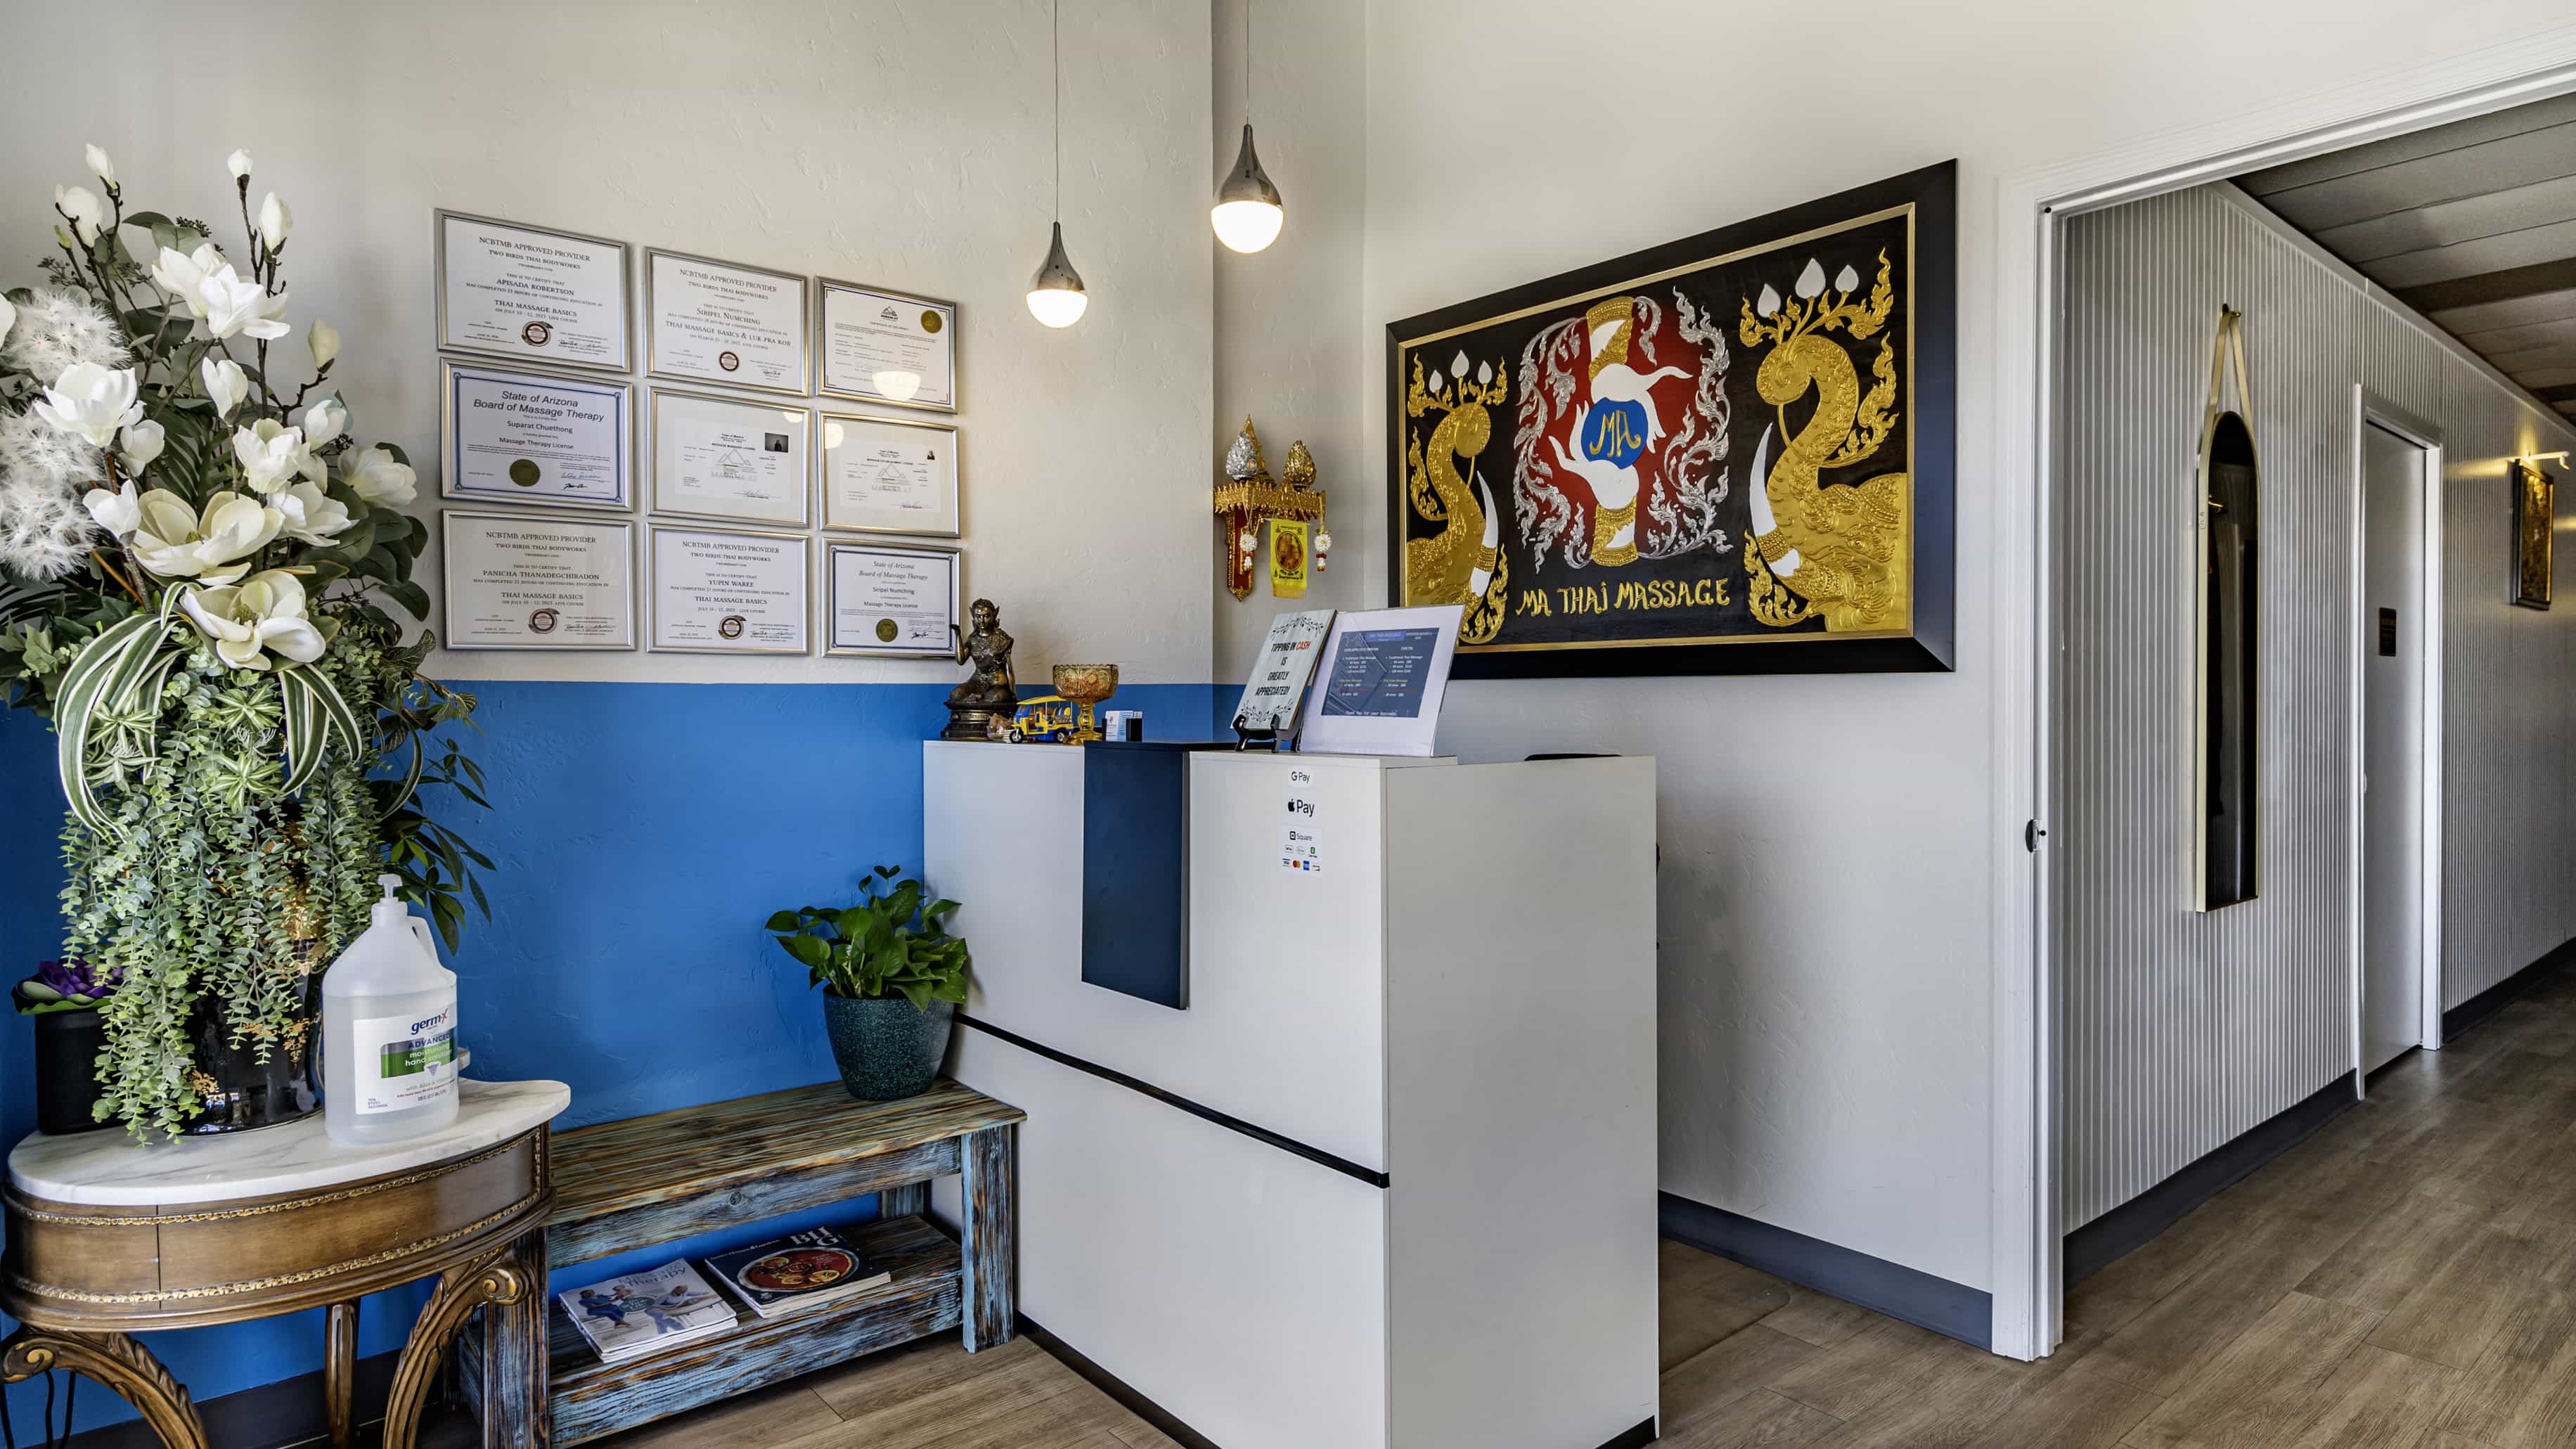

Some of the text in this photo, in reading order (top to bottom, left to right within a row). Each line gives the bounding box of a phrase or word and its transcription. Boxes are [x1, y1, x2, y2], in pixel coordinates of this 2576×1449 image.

[479, 237, 591, 262] NCBTMB APPROVED PROVIDER
[543, 259, 581, 269] BODYWORKS
[496, 279, 574, 295] APISADA ROBERTSON
[680, 269, 777, 292] NCBTMB APPROVED PROVIDER
[495, 300, 513, 308] THAI
[516, 303, 550, 313] MASSAGE
[685, 324, 715, 334] MASSAGE
[718, 330, 739, 338] BASICS
[501, 391, 527, 401] State
[542, 396, 578, 407] Arizona
[473, 399, 604, 422] Board of Massage Therapy
[507, 421, 573, 434] Suparat Chuethong
[1589, 409, 1642, 458] MA
[499, 437, 526, 446] Massage
[527, 439, 552, 449] Therapy
[520, 534, 559, 542] APPROVED
[682, 541, 711, 549] NCBTMB
[1515, 588, 1552, 617] MA
[1614, 577, 1731, 612] MASSAGE
[1271, 641, 1311, 652] TIPPING IN CASH
[1280, 657, 1287, 666] IS
[1268, 671, 1290, 681] GREATLY
[1254, 685, 1291, 696] APPRECIATED!
[1299, 772, 1310, 784] Pay
[1296, 799, 1315, 818] Pay
[1297, 832, 1313, 842] Square
[408, 1033, 451, 1049] ADVANCED
[405, 1057, 426, 1067] hand
